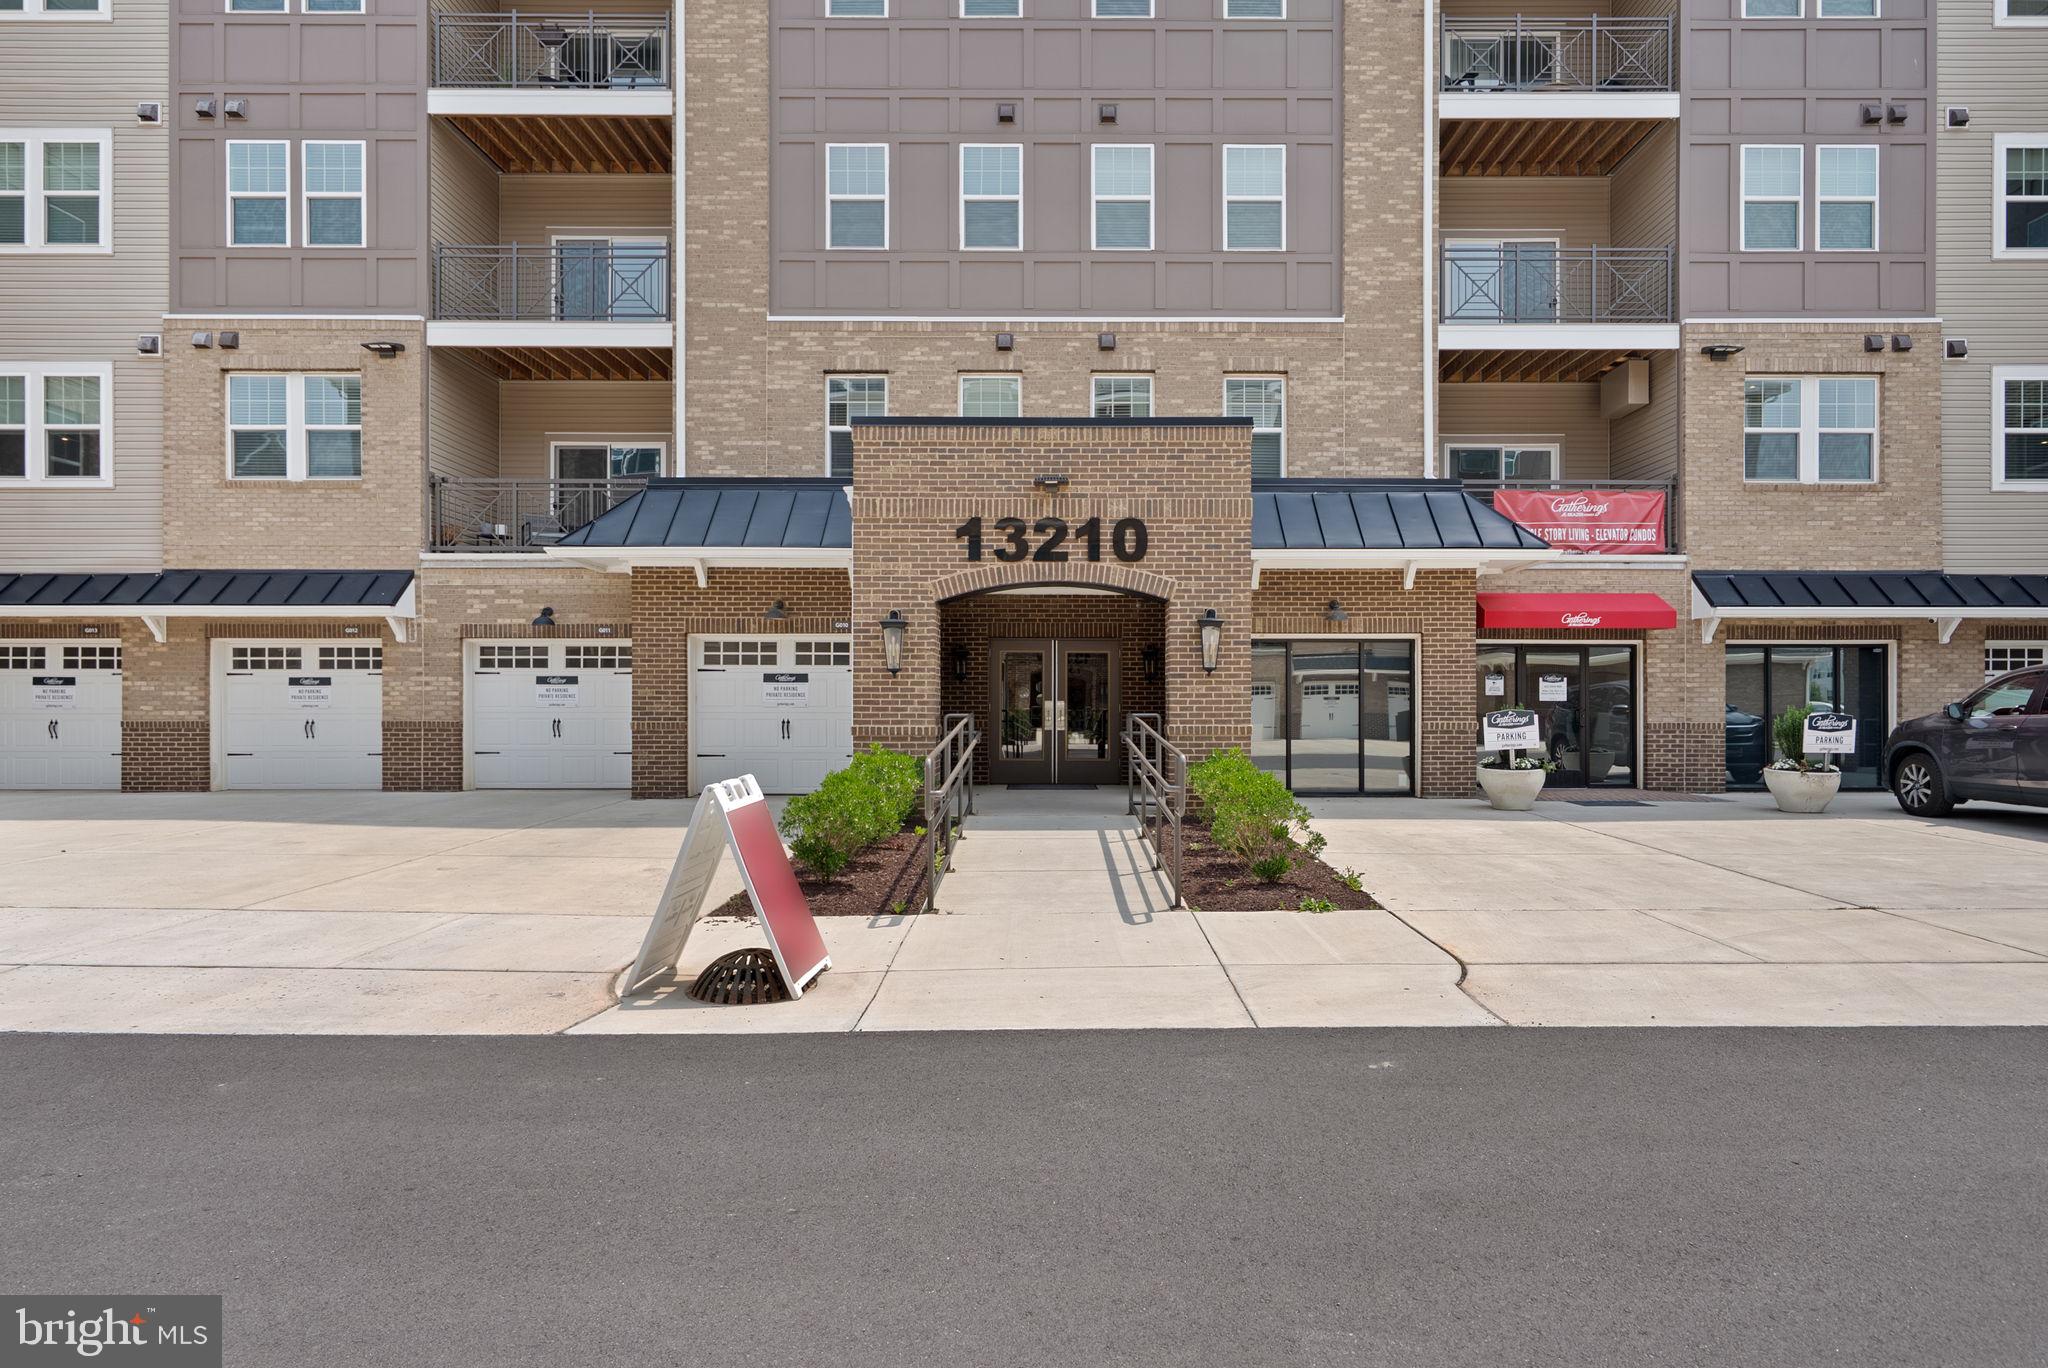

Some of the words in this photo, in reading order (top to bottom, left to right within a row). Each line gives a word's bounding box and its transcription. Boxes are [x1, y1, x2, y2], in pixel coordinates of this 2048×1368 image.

[1551, 497, 1609, 516] Gatherings
[956, 517, 1148, 562] 13210
[1544, 528, 1567, 541] STORY
[1568, 528, 1590, 541] LIVING
[1596, 528, 1628, 541] ELEVATOR
[1629, 528, 1656, 541] CONDOS
[1561, 612, 1602, 626] Gatherings
[1491, 711, 1530, 725] Gatherings
[1812, 715, 1849, 729] Gatherings
[1496, 732, 1527, 741] PARKING
[1815, 735, 1844, 744] PARKING
